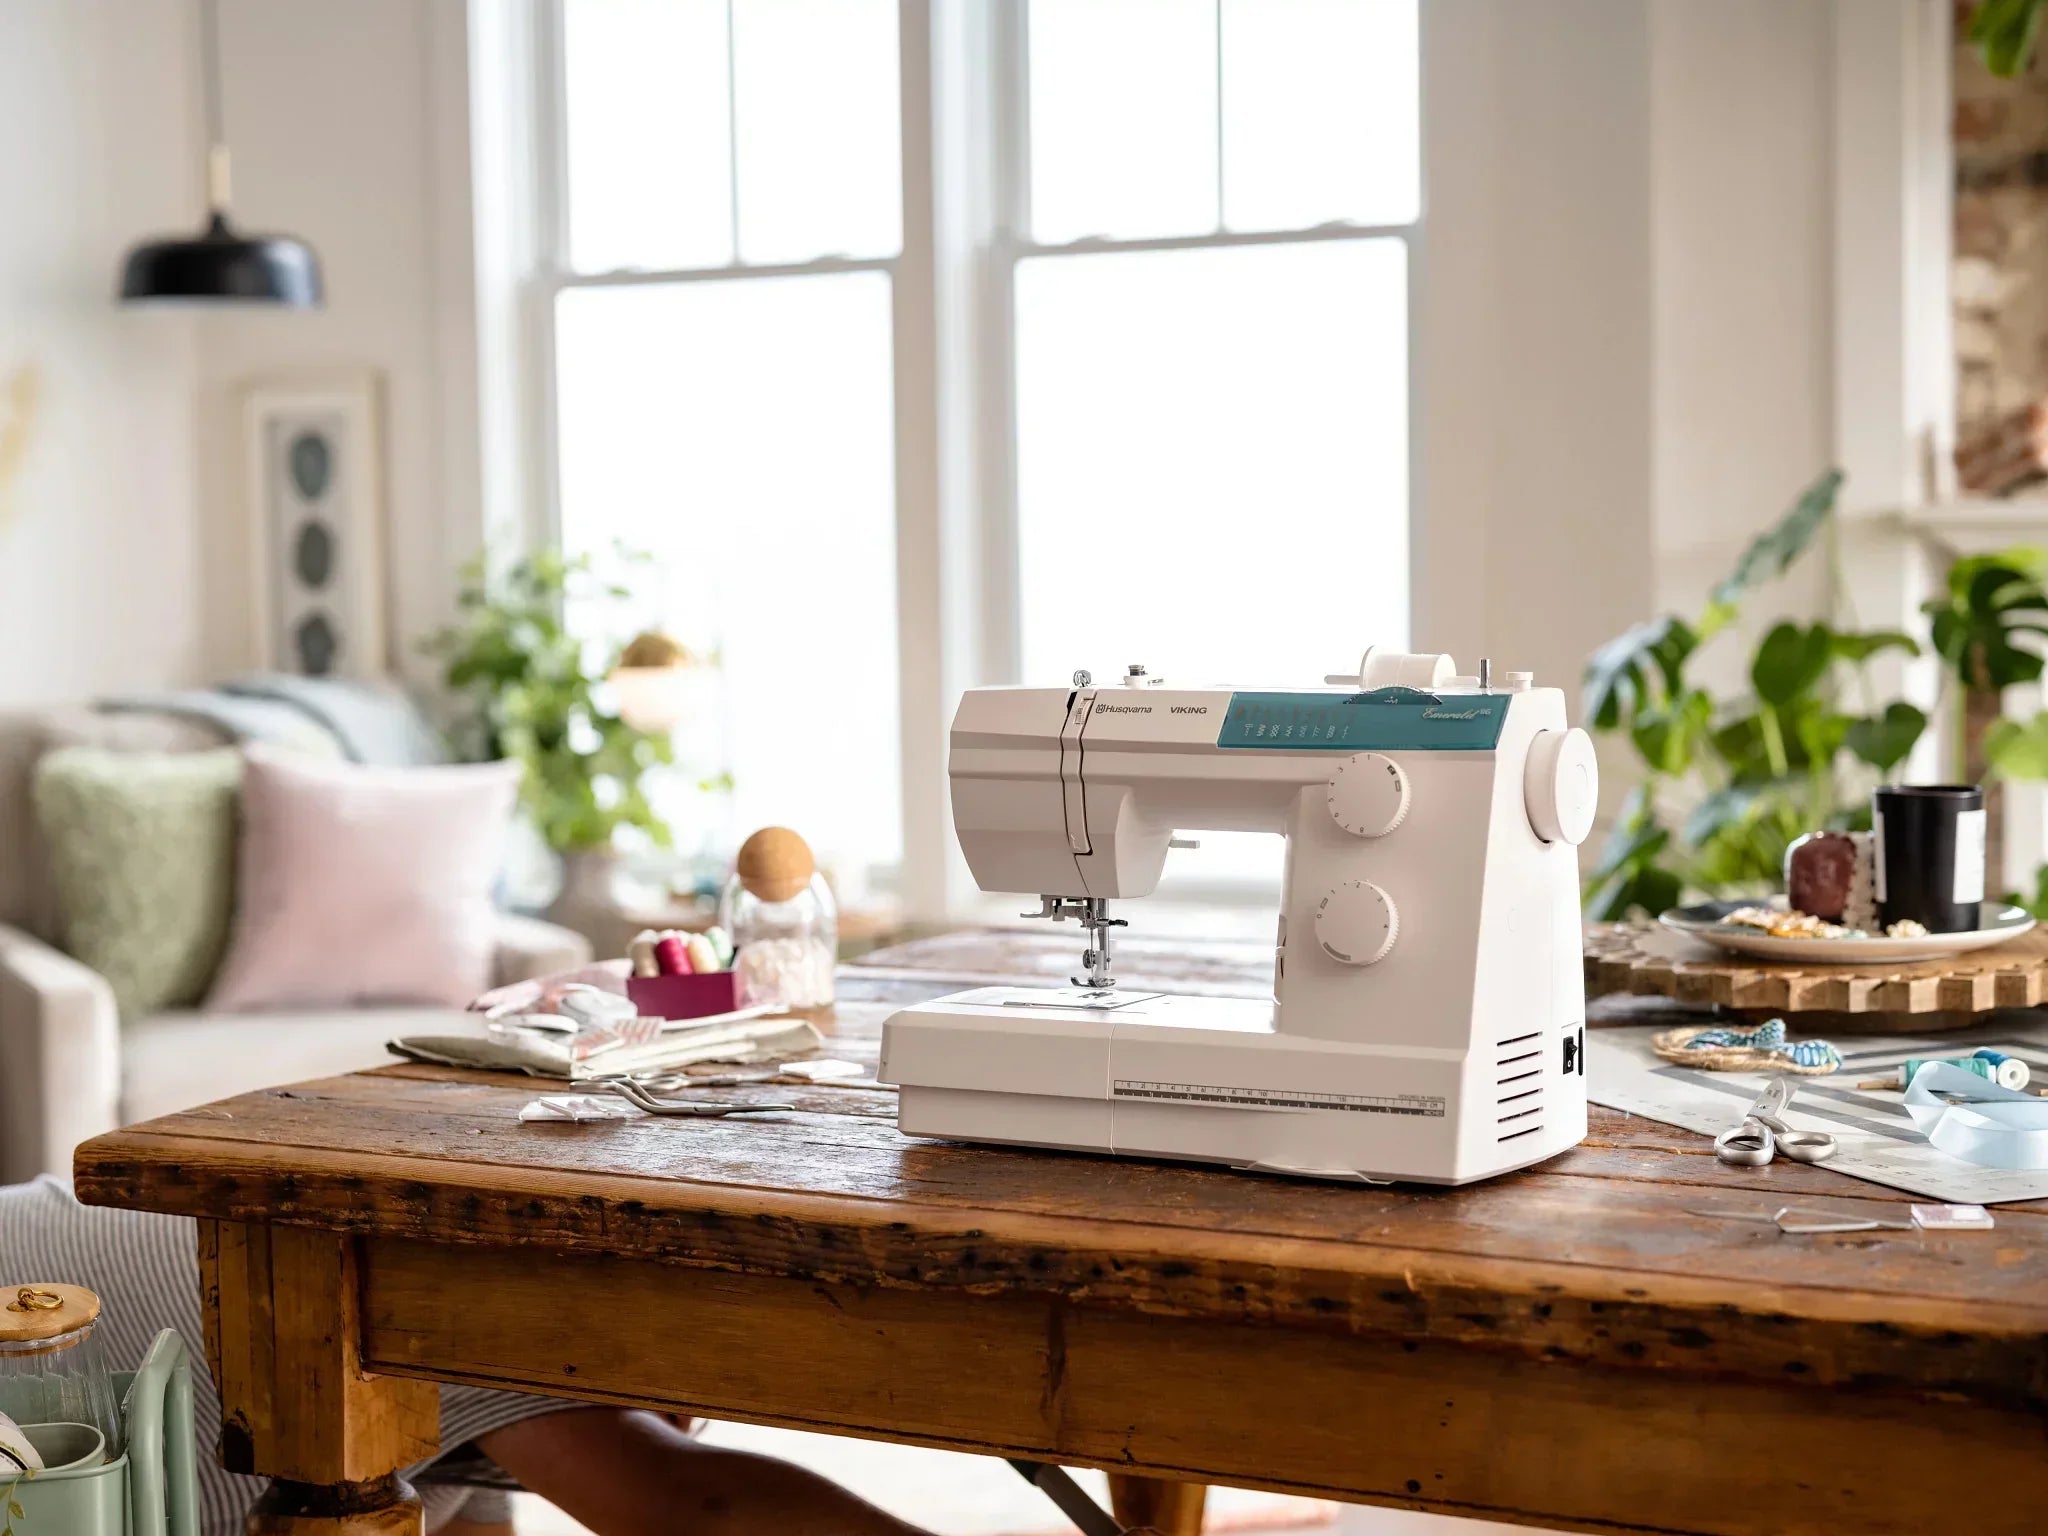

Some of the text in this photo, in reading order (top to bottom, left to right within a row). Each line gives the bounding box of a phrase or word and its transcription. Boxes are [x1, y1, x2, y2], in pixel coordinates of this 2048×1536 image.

[1105, 705, 1207, 715] Husqvarna VIKING
[1422, 707, 1479, 720] Emerald
